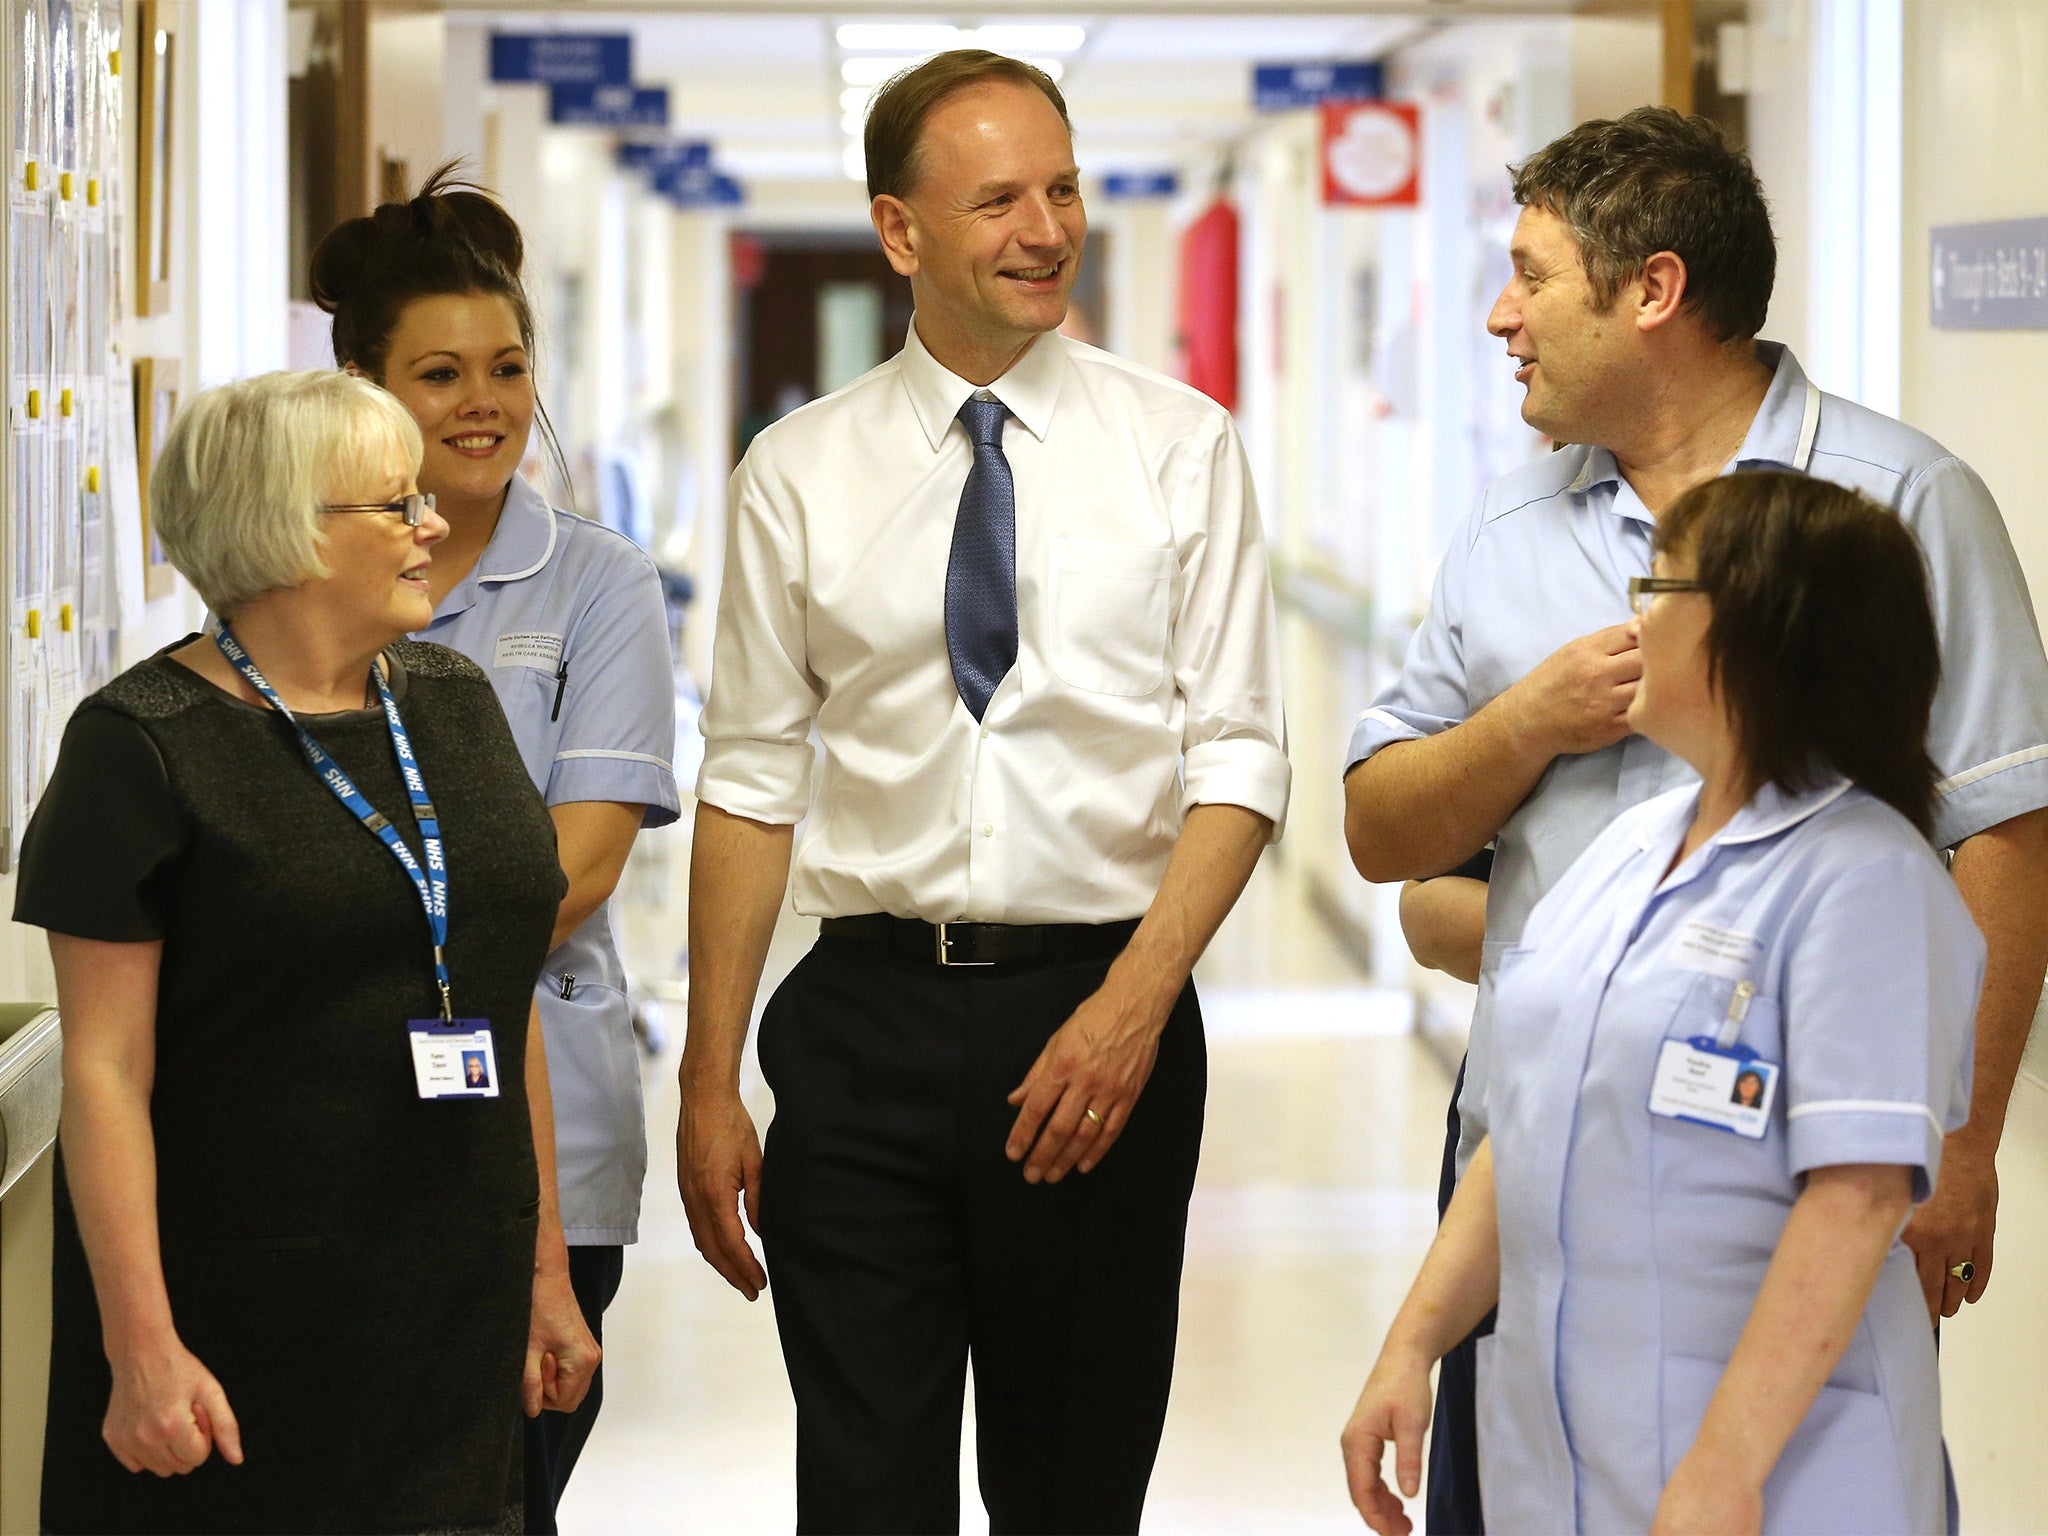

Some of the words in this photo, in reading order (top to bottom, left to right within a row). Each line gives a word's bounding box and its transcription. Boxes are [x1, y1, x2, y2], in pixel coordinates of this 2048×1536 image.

[221, 637, 246, 661] NHS
[241, 664, 270, 690] NHS
[383, 696, 402, 727] NHS
[393, 731, 413, 761] NHS
[324, 767, 356, 799] NHS
[403, 766, 424, 793] NHS
[391, 840, 419, 870] NHS
[424, 838, 444, 872] NHS
[416, 878, 434, 914] NHS
[432, 879, 446, 918] NHS
